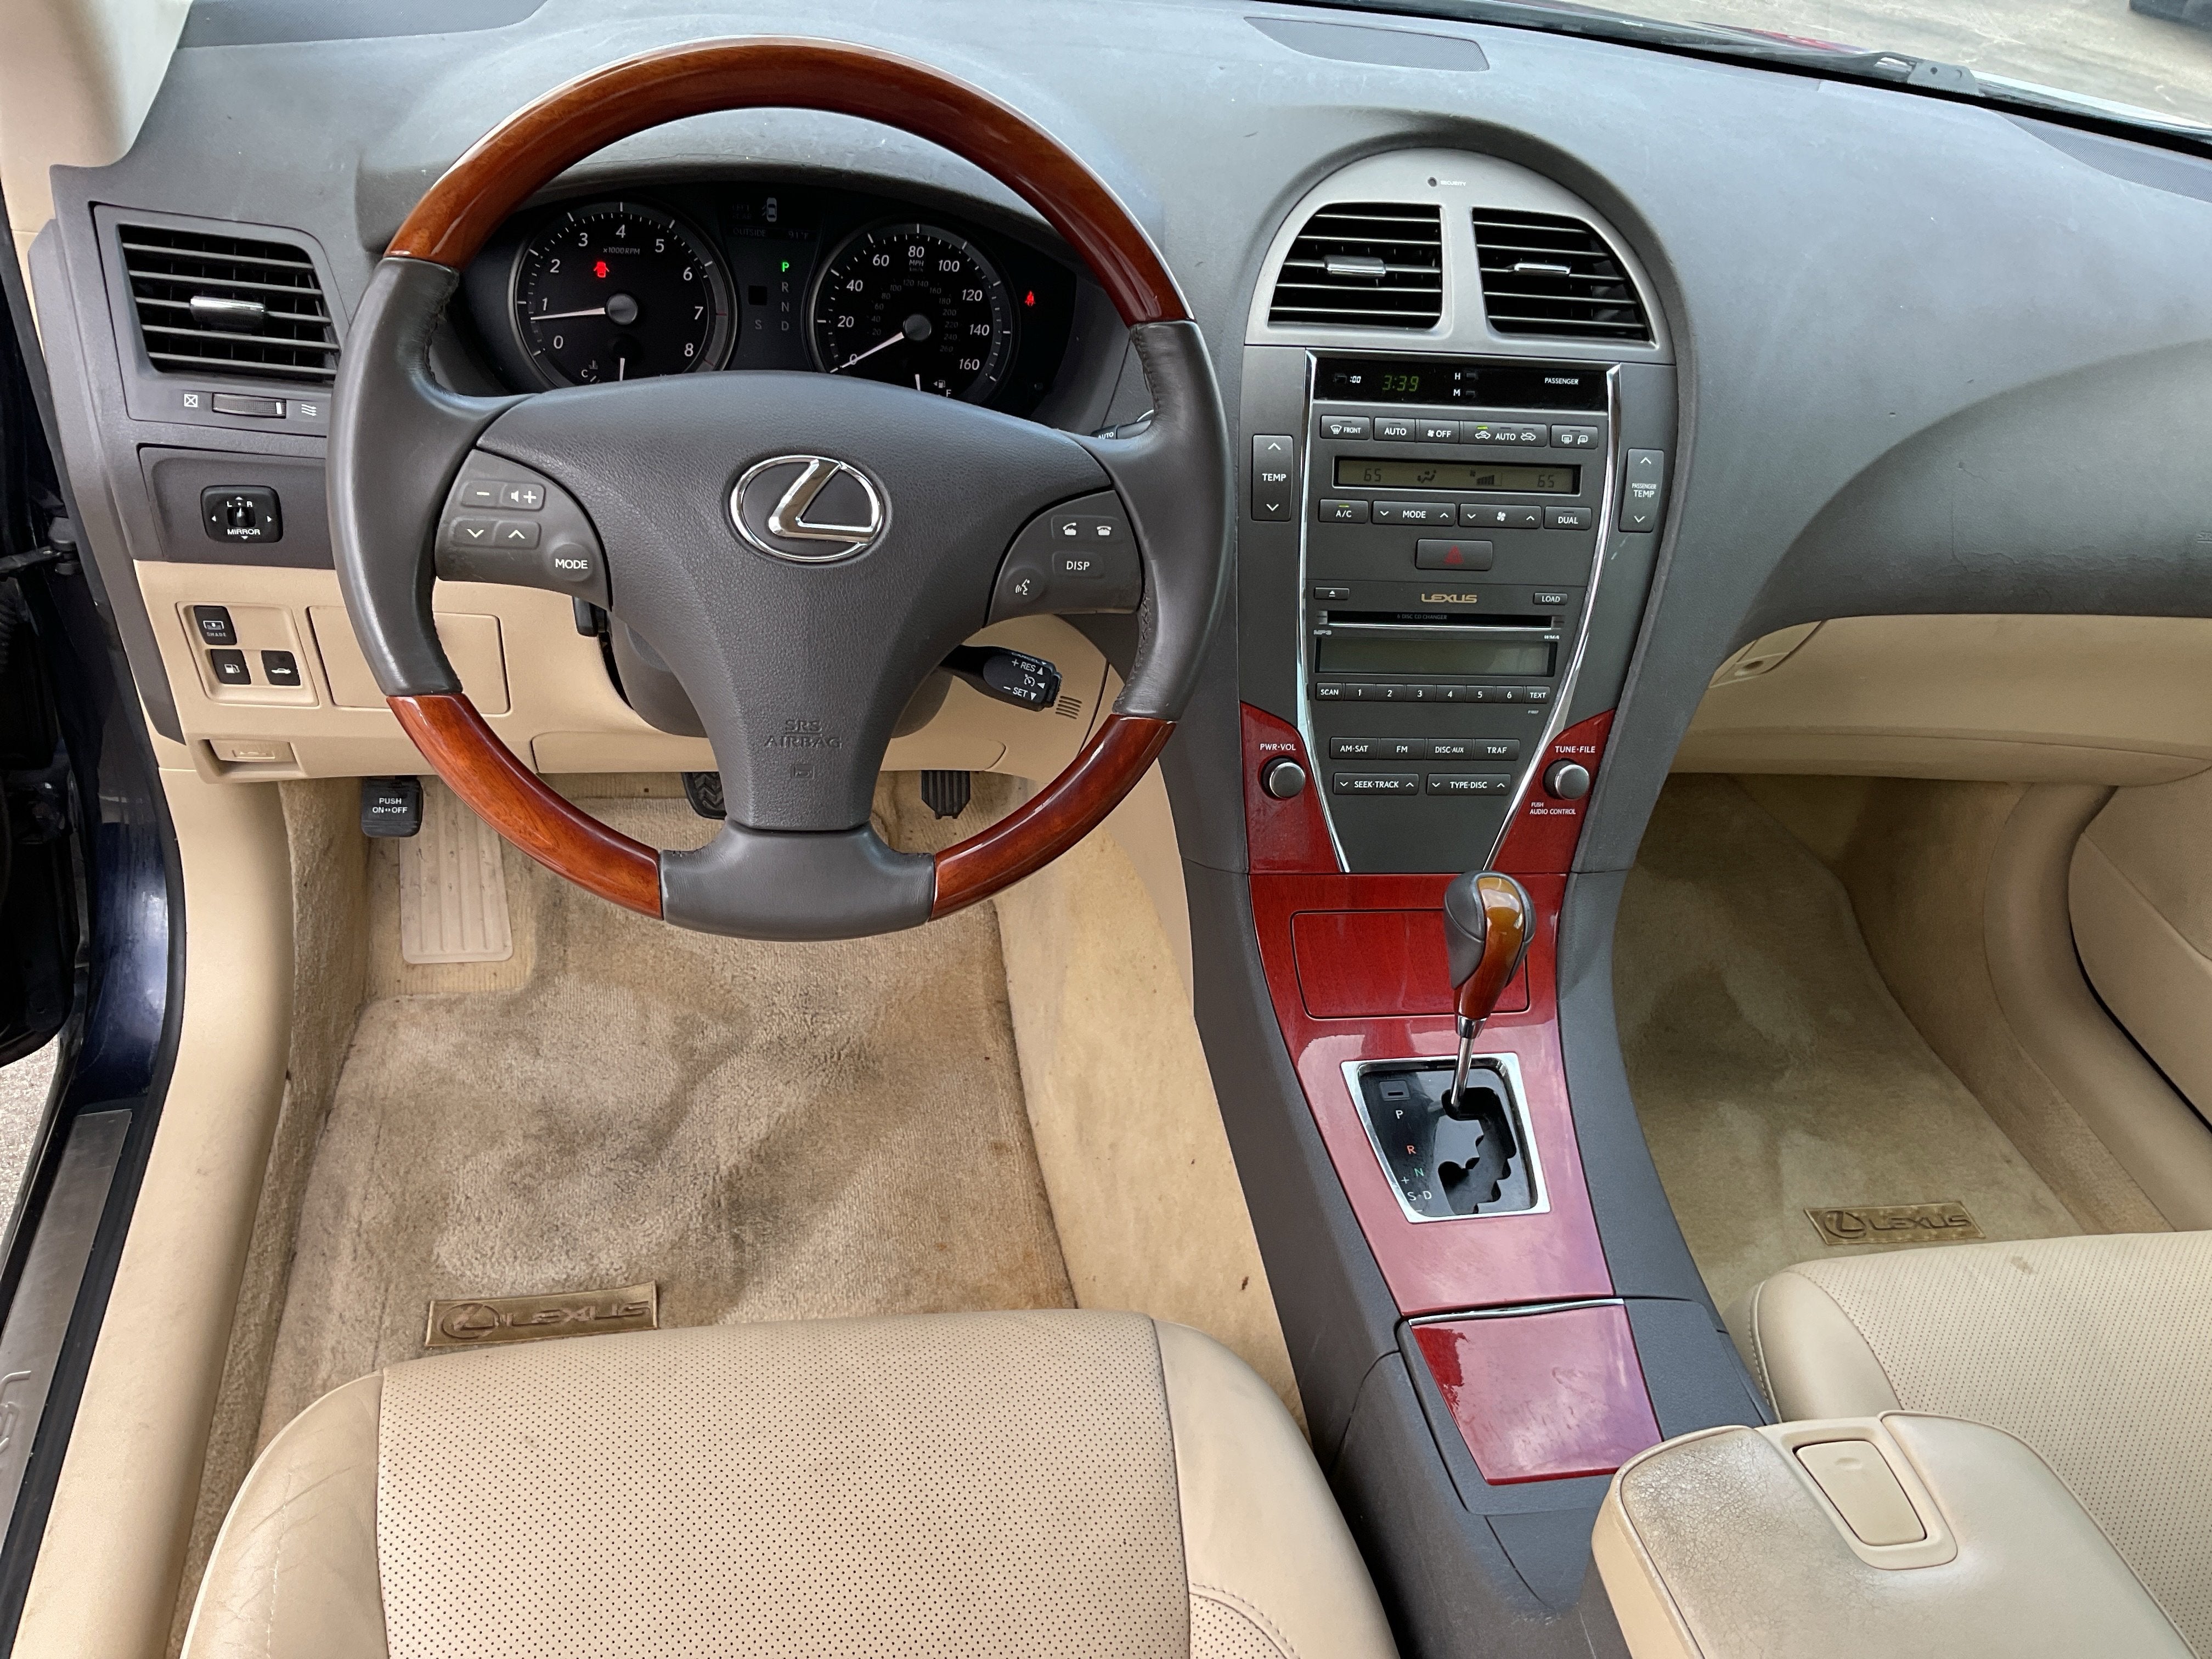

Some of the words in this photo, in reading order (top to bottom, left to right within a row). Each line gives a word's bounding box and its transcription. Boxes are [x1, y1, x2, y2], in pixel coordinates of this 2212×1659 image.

[616, 225, 625, 238] 4
[733, 227, 767, 237] OUTSIDE
[578, 233, 588, 246] 3
[655, 239, 664, 252] 5
[908, 246, 924, 258] 80
[550, 259, 560, 273] 2
[873, 255, 889, 267] 60
[938, 259, 960, 272] 100
[782, 262, 789, 272] P
[683, 267, 692, 281] 6
[781, 281, 789, 292] R
[846, 280, 863, 292] 40
[962, 289, 983, 301] 120
[542, 298, 548, 311] 1
[781, 301, 789, 312] N
[694, 306, 703, 320] 7
[755, 319, 762, 330] S
[781, 320, 789, 331] D
[837, 315, 854, 328] 20
[969, 324, 990, 336] 140
[554, 336, 563, 349] 0
[685, 343, 693, 357] 8
[850, 354, 857, 364] 0
[959, 359, 980, 370] 160
[582, 369, 588, 377] C
[1383, 375, 1419, 392] 3:39
[1384, 428, 1407, 436] AUTO
[1262, 473, 1286, 482] TEMP
[1364, 468, 1381, 482] 65
[1538, 475, 1554, 488] 65
[1633, 490, 1655, 498] TEMP
[1402, 510, 1426, 518] MODE
[1558, 516, 1578, 524] DUAL
[555, 558, 588, 569] MODE
[1066, 561, 1090, 571] DISP
[1421, 594, 1477, 603] LEXUS
[1020, 662, 1036, 672] RES
[1012, 687, 1028, 697] SET
[1395, 1110, 1403, 1119] P
[1407, 1145, 1416, 1155] R
[1414, 1167, 1424, 1177] N
[1407, 1191, 1416, 1200] S
[1423, 1190, 1432, 1200] D
[1869, 1215, 1972, 1231] LEXUS
[500, 1300, 652, 1327] LEXUS
